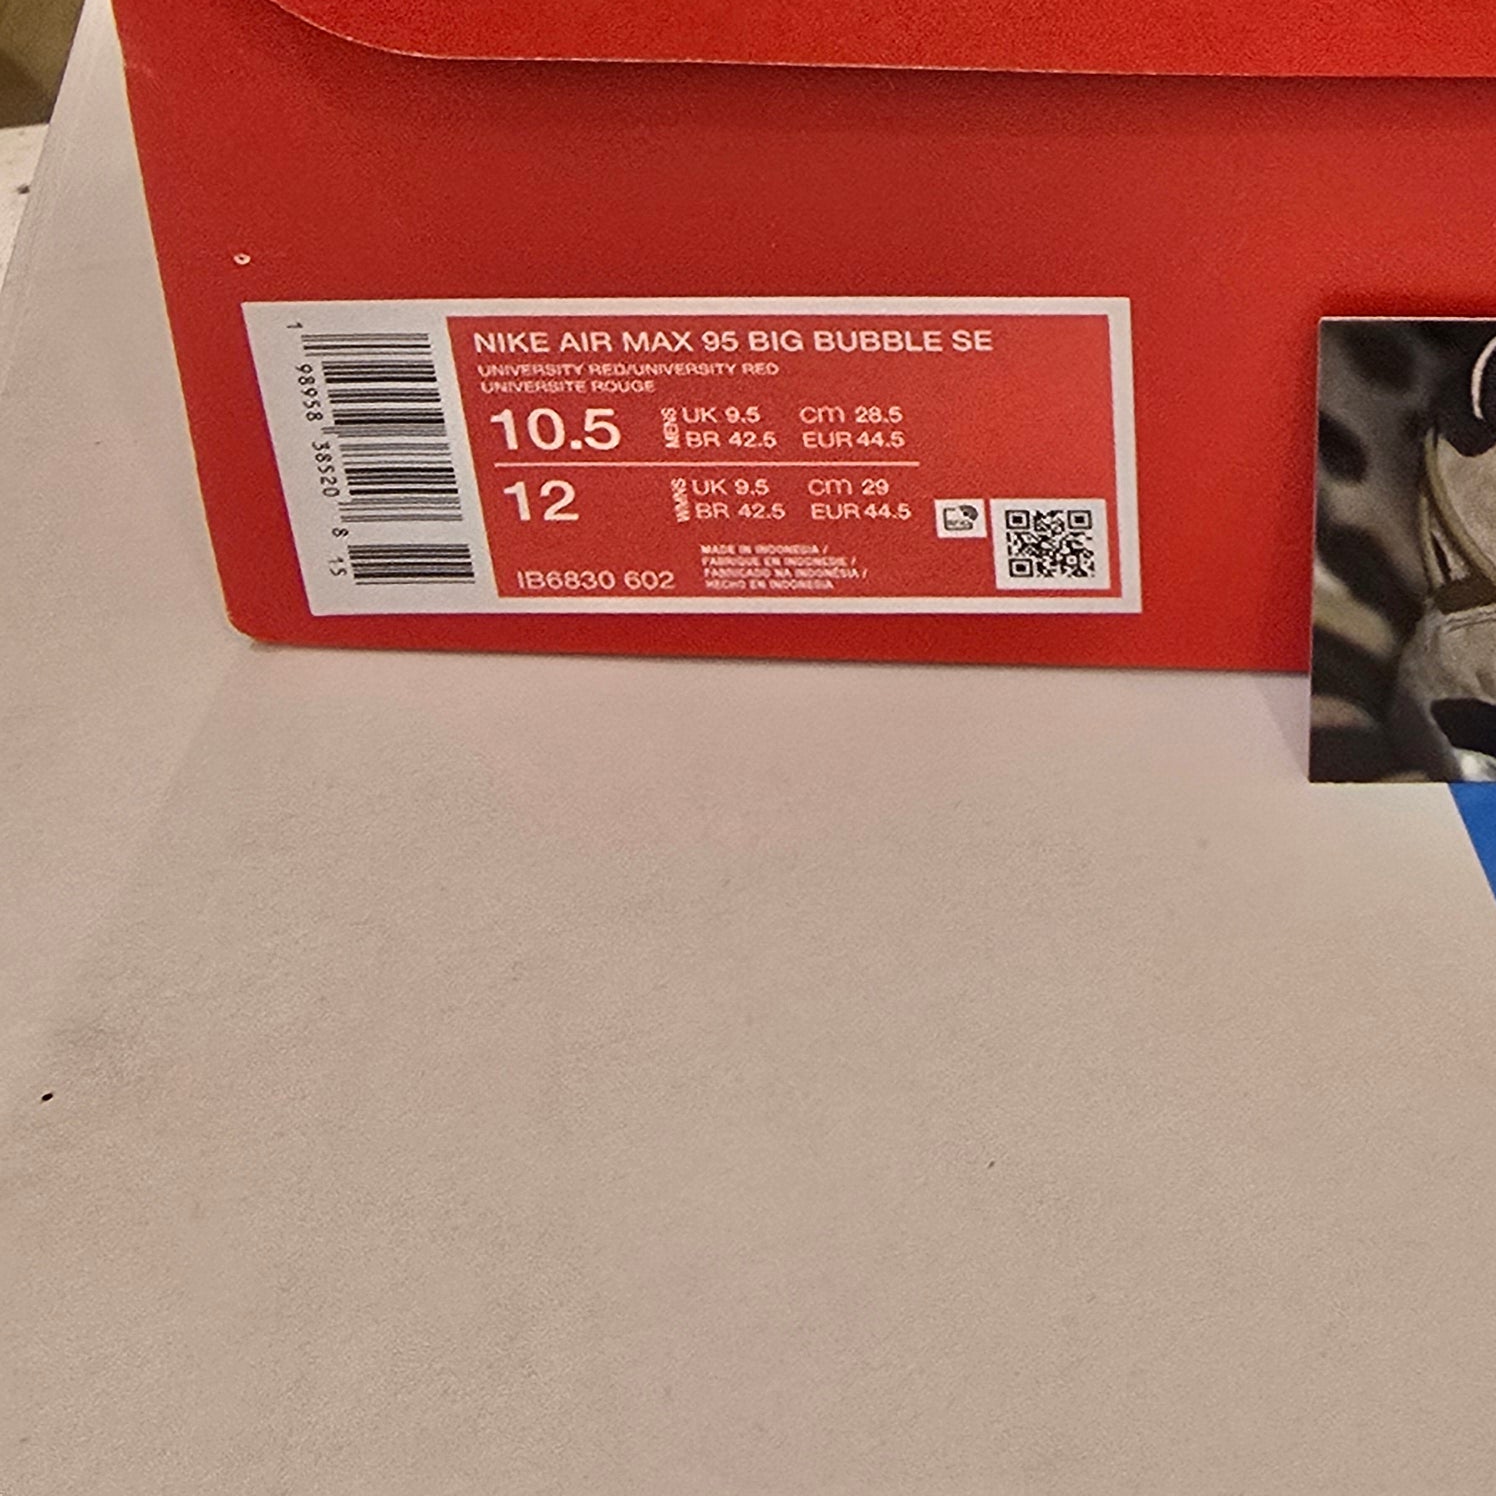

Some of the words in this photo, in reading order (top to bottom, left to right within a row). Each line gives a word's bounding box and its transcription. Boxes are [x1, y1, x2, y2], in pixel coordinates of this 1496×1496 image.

[473, 331, 550, 353] NIKE
[560, 331, 613, 352] AIR
[622, 331, 694, 352] MAX
[701, 330, 739, 352] 95
[748, 330, 804, 352] BIG
[813, 330, 943, 352] BUBBLE
[952, 329, 993, 351] SE
[478, 363, 585, 377] UNIVERSITY
[588, 362, 736, 377] RED/UNIVERSITY
[742, 362, 780, 375] RED
[481, 380, 586, 393] UNIVERSITE
[591, 379, 656, 393] ROUGE
[682, 406, 718, 423] UK
[725, 406, 761, 423] 9.5
[855, 406, 903, 423] 28.5
[490, 407, 621, 451] 10.5
[661, 406, 681, 448] MENS
[685, 431, 721, 448] BR
[728, 431, 777, 448] 42.5
[802, 431, 853, 448] EUR
[856, 431, 906, 448] 44.5
[295, 363, 324, 422] 98958
[311, 441, 340, 497] 38520
[331, 527, 349, 538] 8
[692, 479, 729, 496] UK
[734, 478, 770, 496] 9.5
[861, 478, 890, 495] 29
[504, 479, 580, 521] 12
[695, 503, 731, 520] BR
[737, 503, 786, 520] 42.5
[811, 503, 860, 520] EUR
[863, 503, 912, 520] 44.5
[700, 544, 736, 554] MADE
[738, 544, 752, 554] IN
[754, 544, 820, 554] INDONESIA
[327, 557, 348, 577] 15
[763, 556, 781, 567] EN
[517, 570, 616, 591] IB6830
[624, 570, 675, 591] 602
[749, 579, 767, 590] EN
